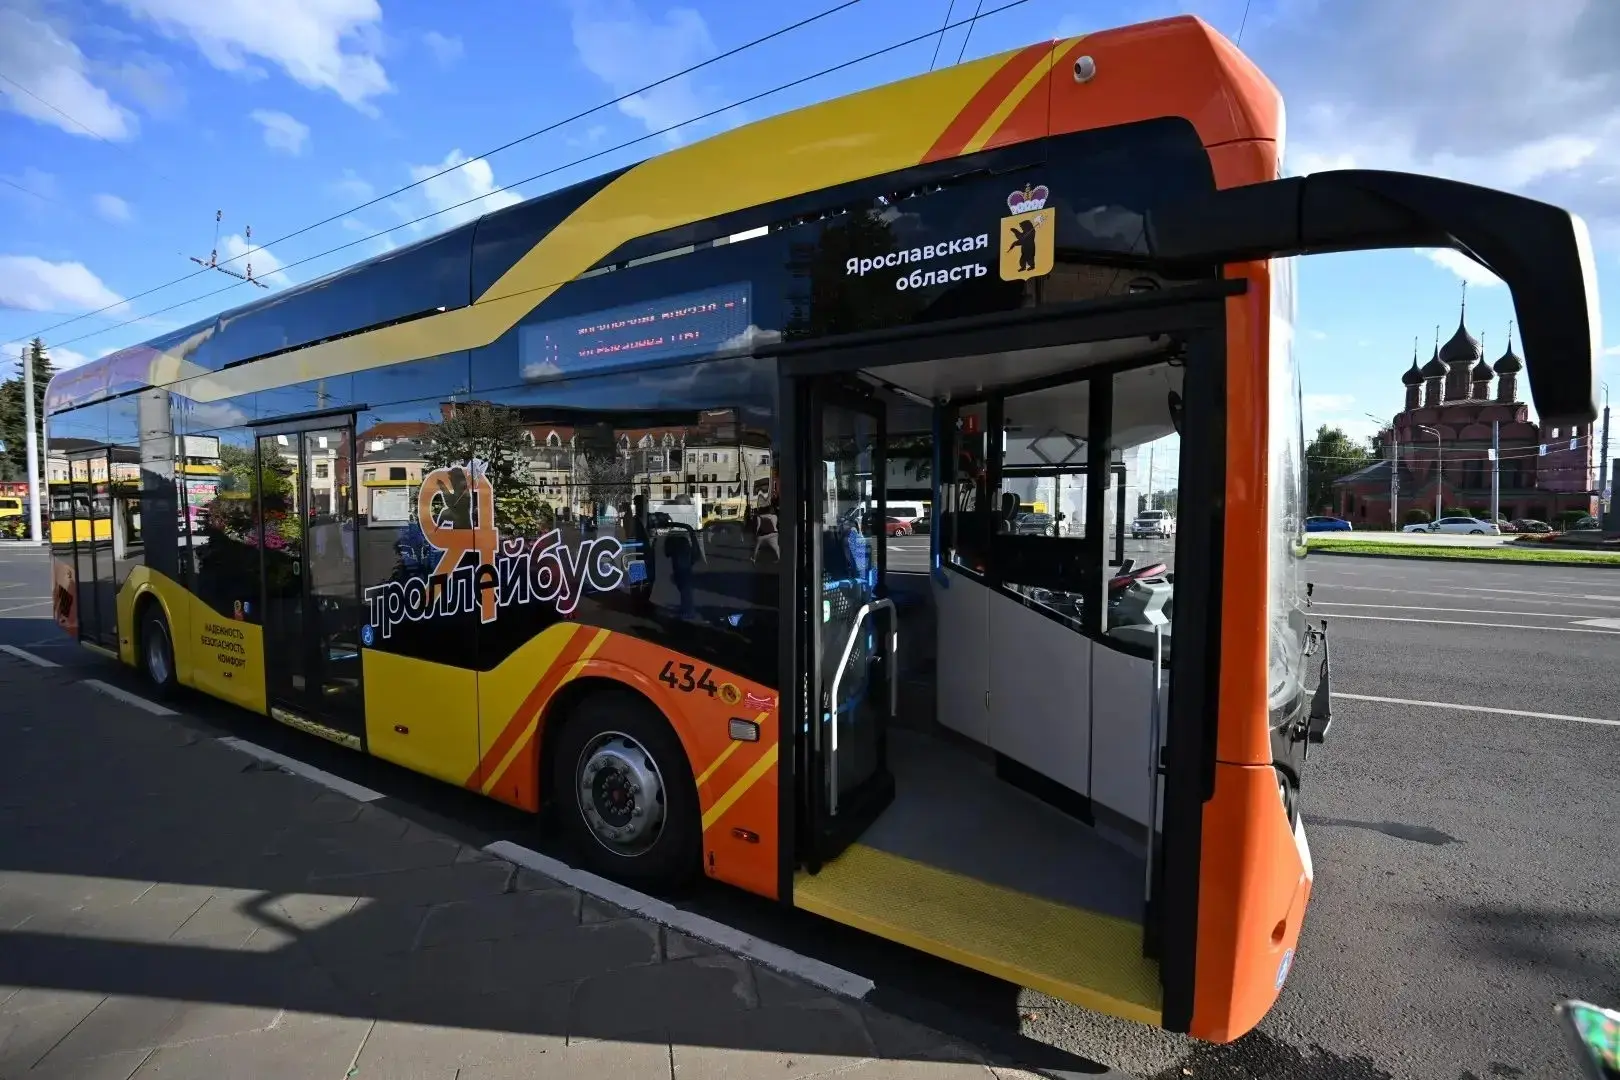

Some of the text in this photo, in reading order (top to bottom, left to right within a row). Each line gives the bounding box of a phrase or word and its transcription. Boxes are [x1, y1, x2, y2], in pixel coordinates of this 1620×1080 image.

[846, 232, 989, 277] Ярославская
[895, 263, 988, 291] область
[217, 653, 246, 669] КОМФОРТ
[658, 660, 718, 698] 434
